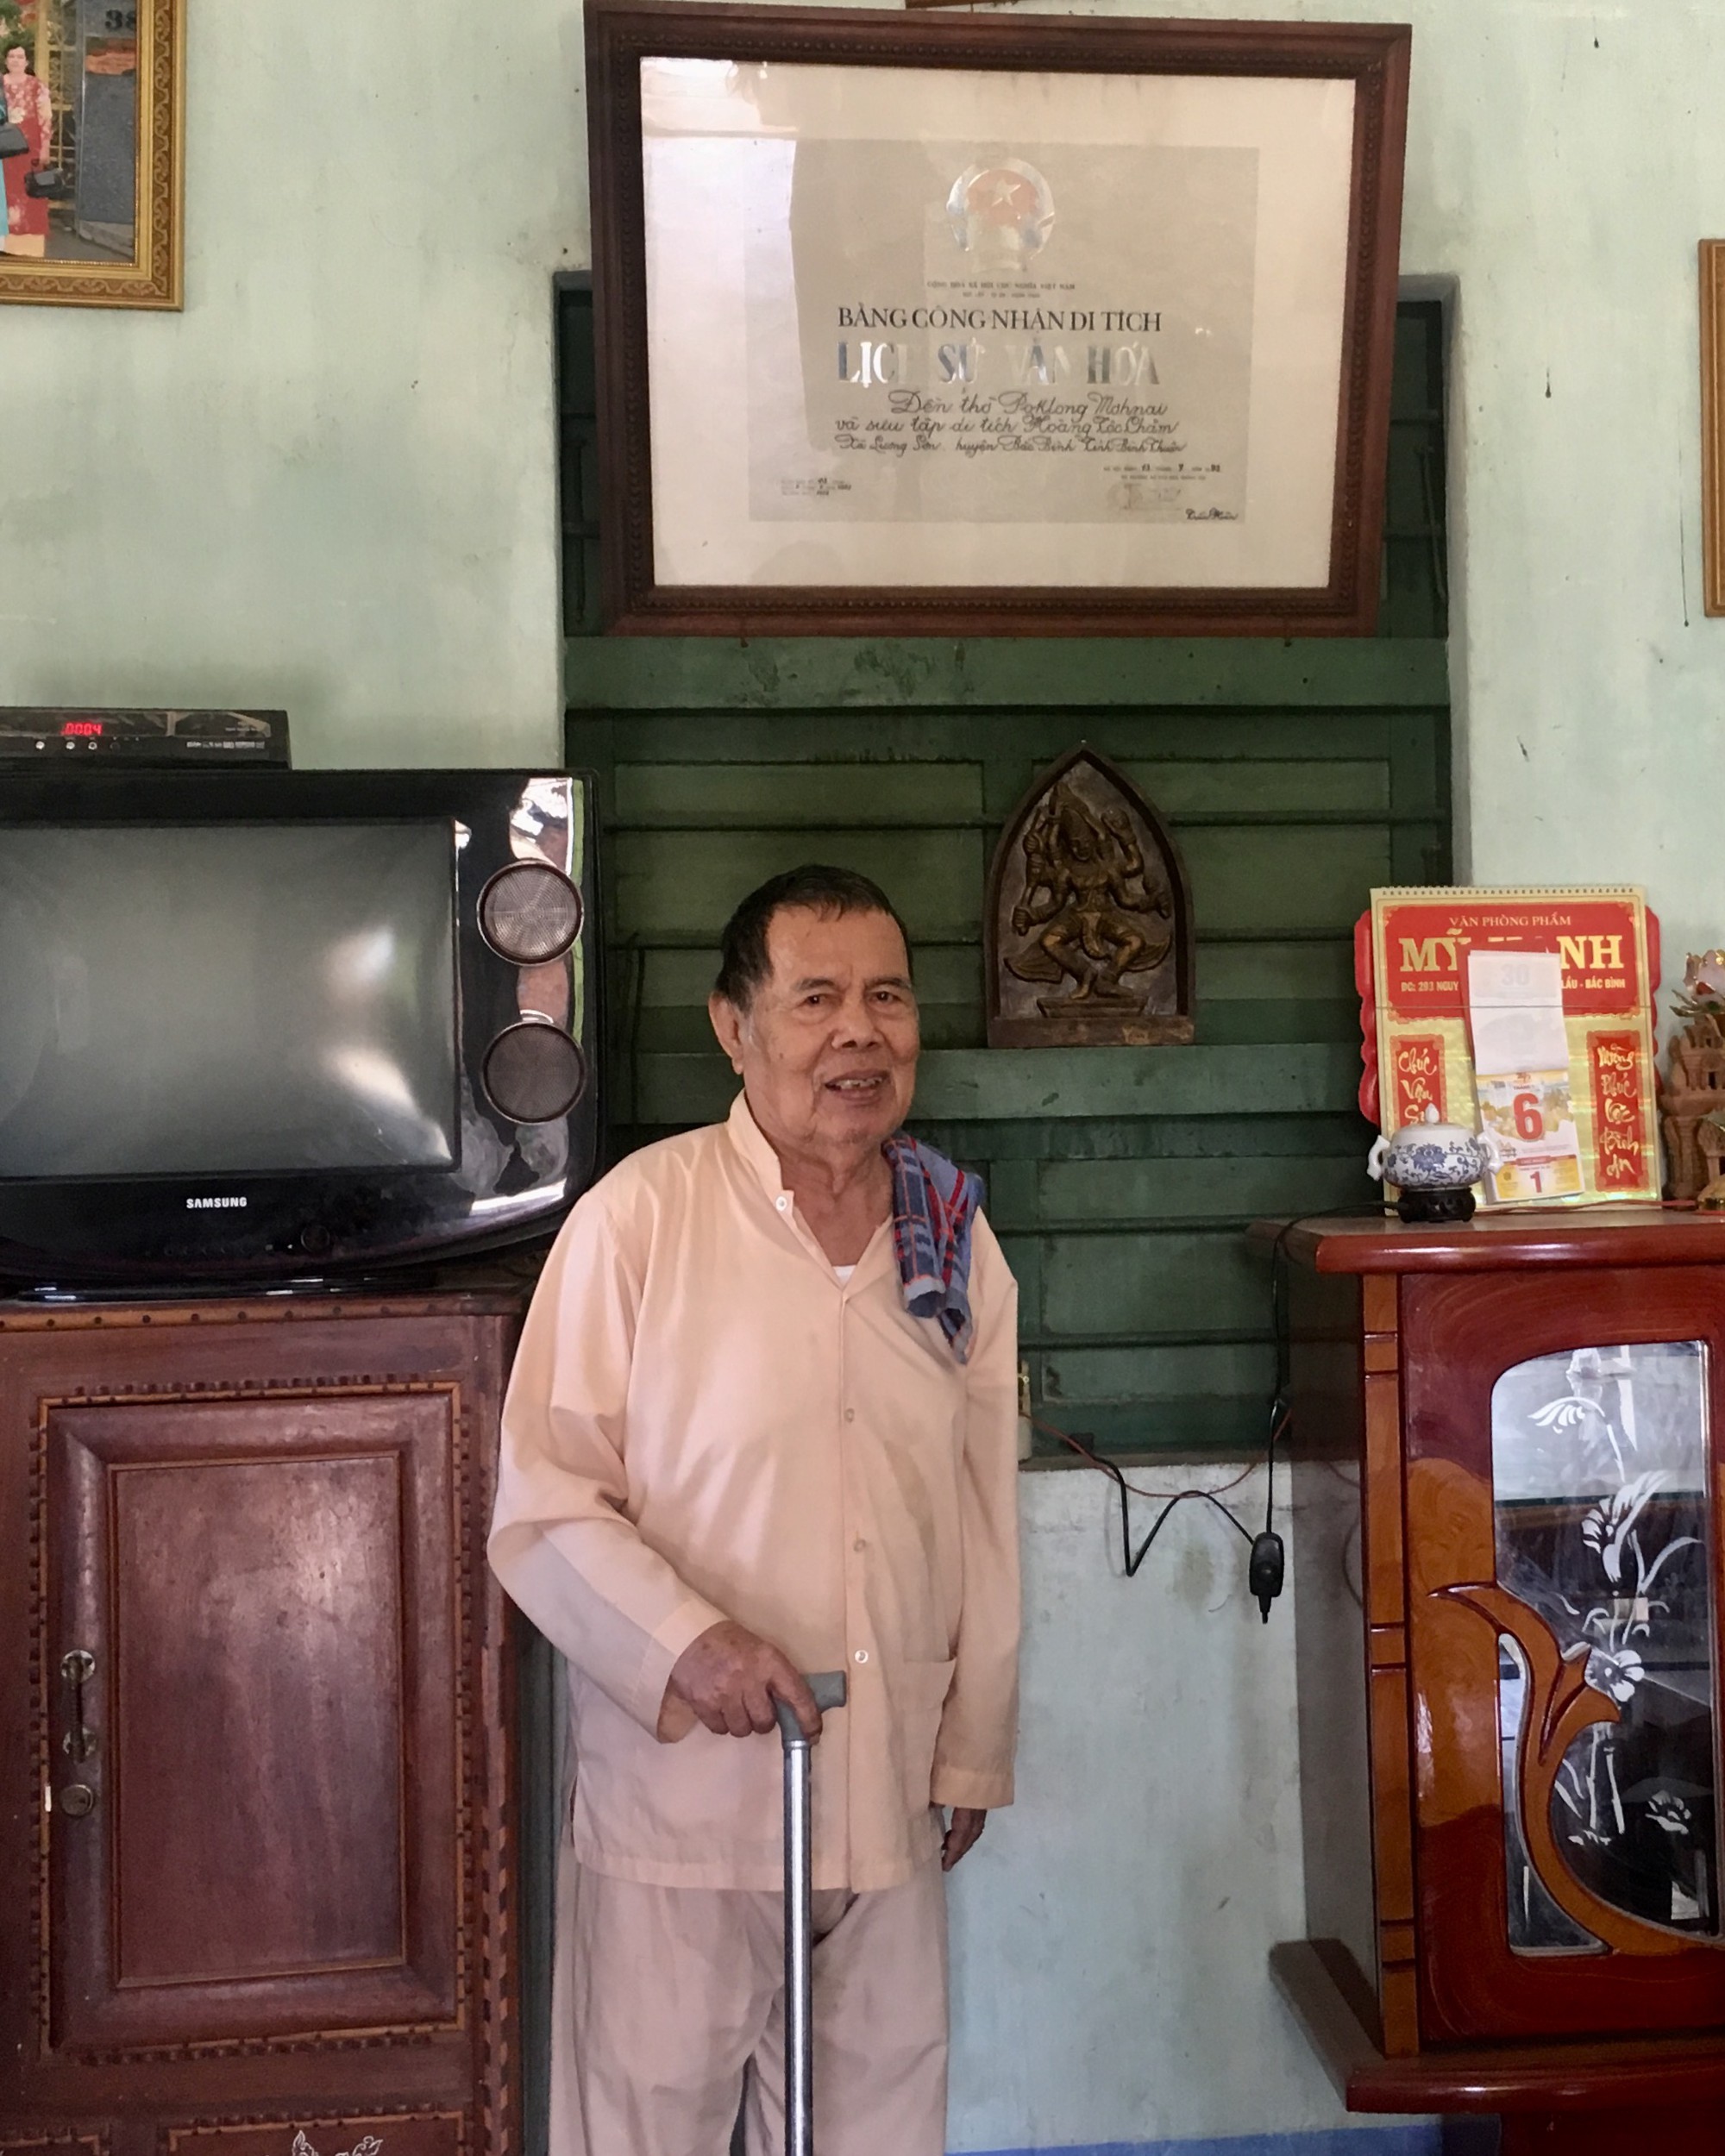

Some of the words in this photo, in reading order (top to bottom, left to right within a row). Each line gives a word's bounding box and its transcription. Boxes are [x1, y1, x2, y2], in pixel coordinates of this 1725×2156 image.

[912, 304, 986, 329] CÔNG
[1070, 311, 1095, 332] DI
[888, 389, 953, 414] Đền
[835, 417, 861, 431] và
[1449, 914, 1479, 927] VĂN
[1482, 913, 1529, 927] PHÒNG
[1532, 912, 1571, 926] PHẨM
[1398, 1047, 1438, 1075] Chúc
[1400, 1077, 1433, 1103] Vạn
[1601, 1072, 1637, 1098] Phúc
[1514, 1093, 1544, 1140] 6
[1600, 1125, 1640, 1156] Bình
[1606, 1153, 1636, 1180] An
[1530, 1171, 1542, 1193] 1
[185, 1197, 248, 1208] SAMSUNG
